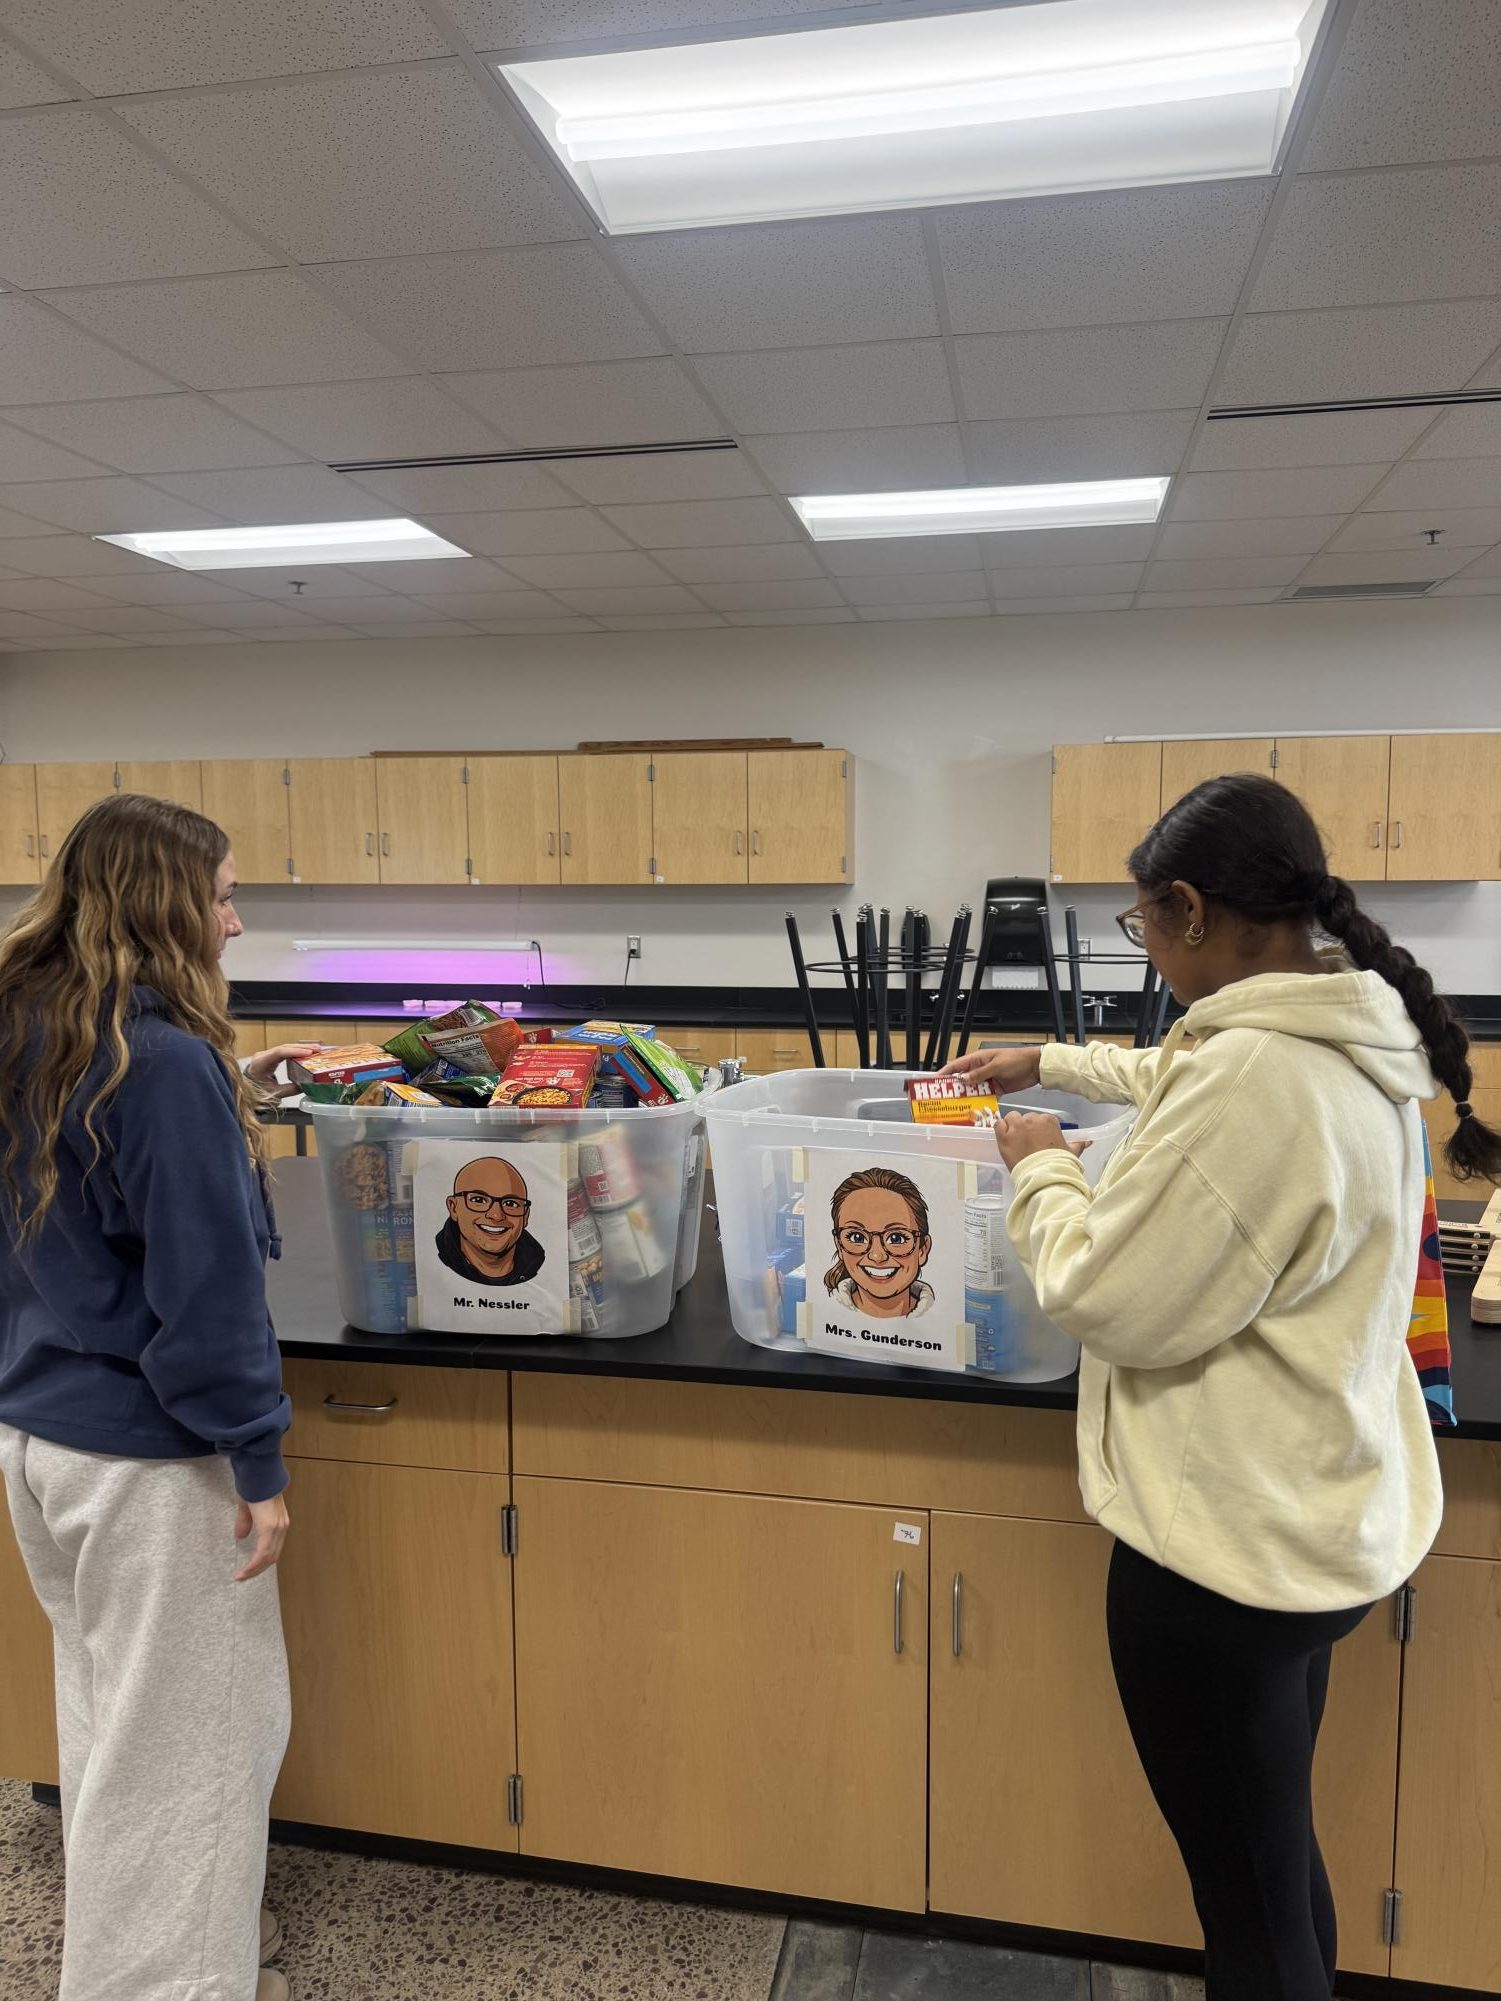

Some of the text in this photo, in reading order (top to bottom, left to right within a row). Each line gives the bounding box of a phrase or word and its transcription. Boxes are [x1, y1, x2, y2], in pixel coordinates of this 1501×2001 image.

[913, 1081, 992, 1101] HELPER
[453, 1297, 530, 1310] Mr. Nessler
[825, 1323, 942, 1351] Mrs. Gunderson
